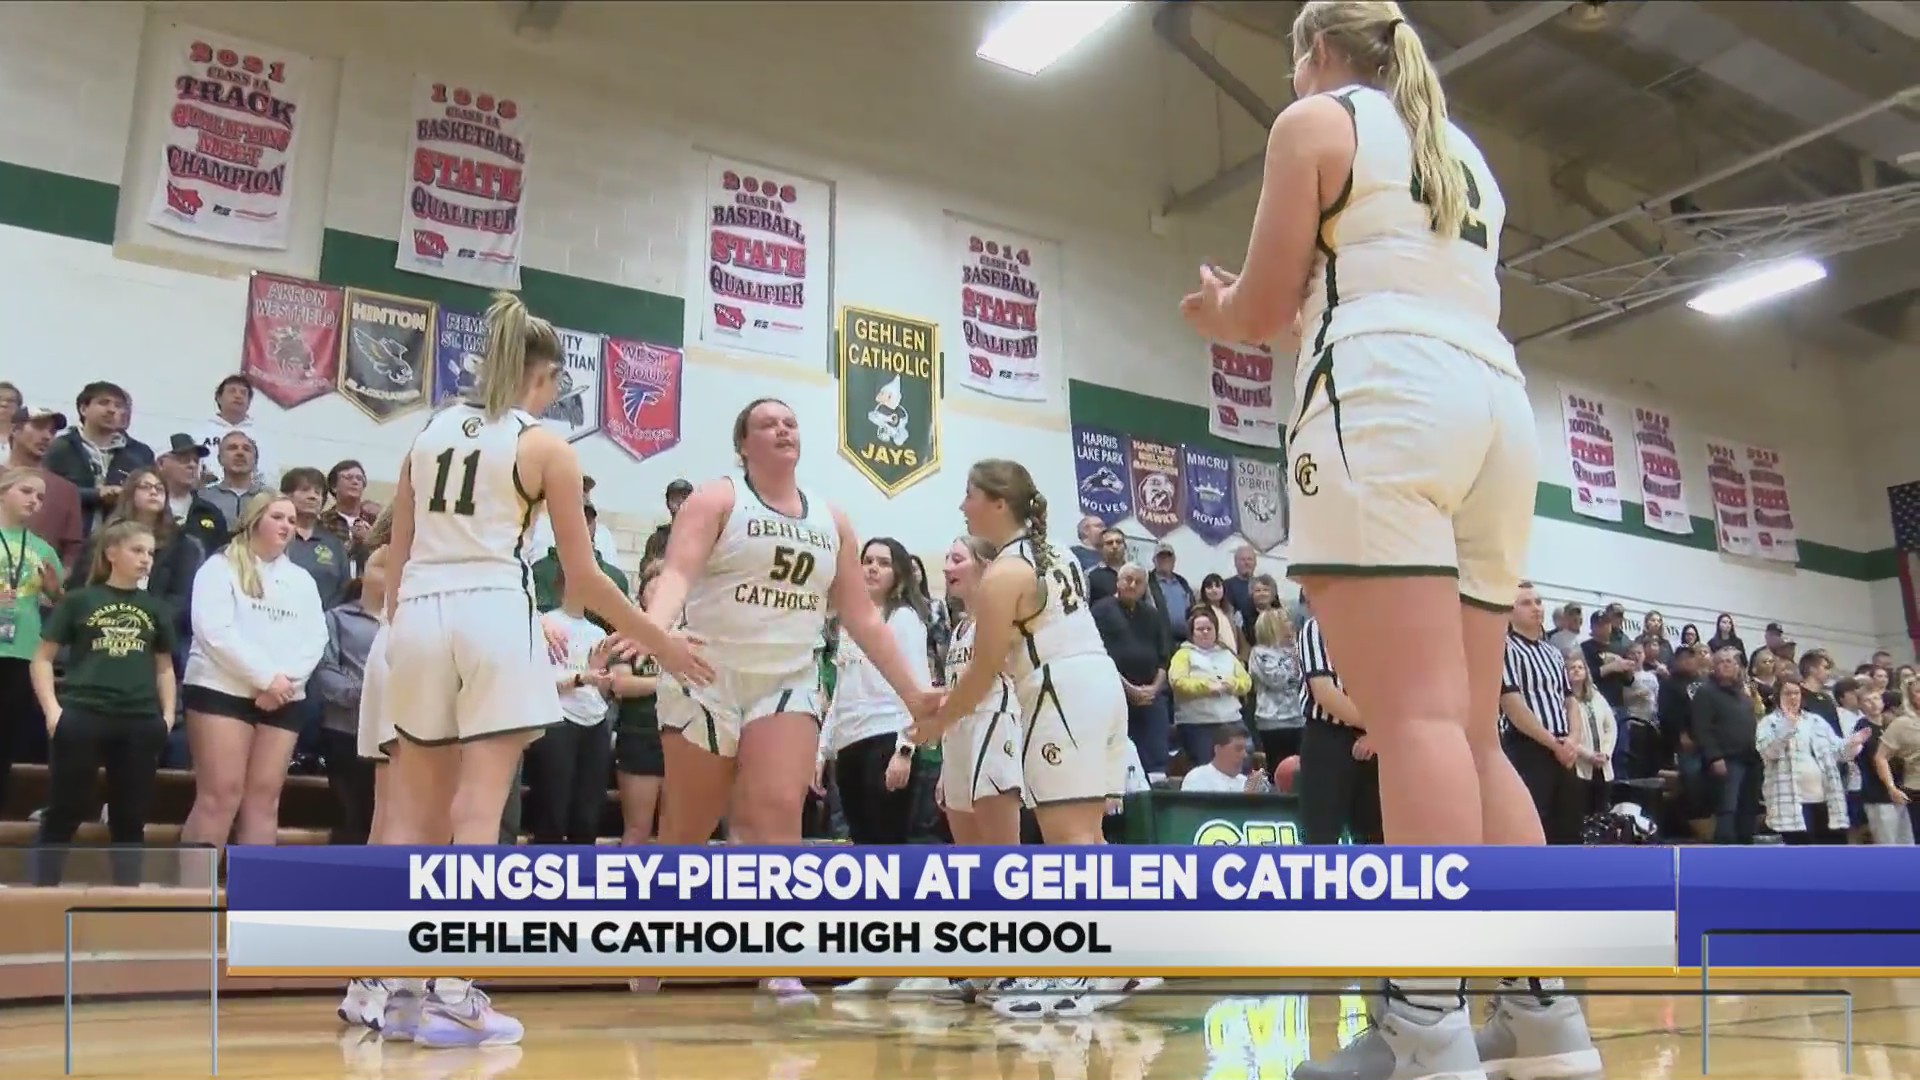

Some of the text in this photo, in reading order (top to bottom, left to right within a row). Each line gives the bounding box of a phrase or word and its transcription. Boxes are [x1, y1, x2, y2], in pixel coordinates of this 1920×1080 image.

[190, 41, 285, 83] 2021
[207, 66, 250, 87] CLASS
[175, 75, 296, 130] TRACK
[446, 106, 484, 124] CLASS
[197, 131, 263, 167] MEET
[415, 119, 525, 165] BASKETBALL
[167, 145, 287, 196] CHAMPION
[413, 147, 523, 203] STATE
[412, 186, 517, 235] QUALIFIER
[735, 192, 769, 210] CLASS
[712, 205, 805, 247] BASEBALL
[710, 229, 806, 279] STATE
[969, 236, 1031, 266] 2014
[268, 282, 327, 307] AKRON
[710, 264, 804, 309] QUALIFIER
[962, 265, 1039, 300] BASEBALL
[256, 299, 337, 327] WESTFIELD
[353, 301, 427, 331] HINTON
[962, 287, 1037, 332] STATE
[855, 318, 925, 351] GEHLEN
[963, 320, 1038, 359] QUALIFIER
[614, 360, 671, 382] SIOUX
[621, 343, 667, 366] WEST
[848, 344, 930, 378] CATHOLIC
[1082, 431, 1118, 447] HARRIS
[1568, 418, 1613, 442] FOOTBALL
[860, 443, 917, 466] JAYS
[1077, 446, 1101, 463] LAKE
[1101, 449, 1124, 466] PARK
[1187, 453, 1229, 470] MMCRU
[429, 447, 481, 516] 11
[1080, 496, 1128, 512] WOLVES
[1139, 508, 1178, 524] HAWKS
[1193, 508, 1232, 526] ROYALS
[747, 519, 832, 552] GEHLEN
[769, 545, 815, 586] 50
[1053, 561, 1084, 615] 24
